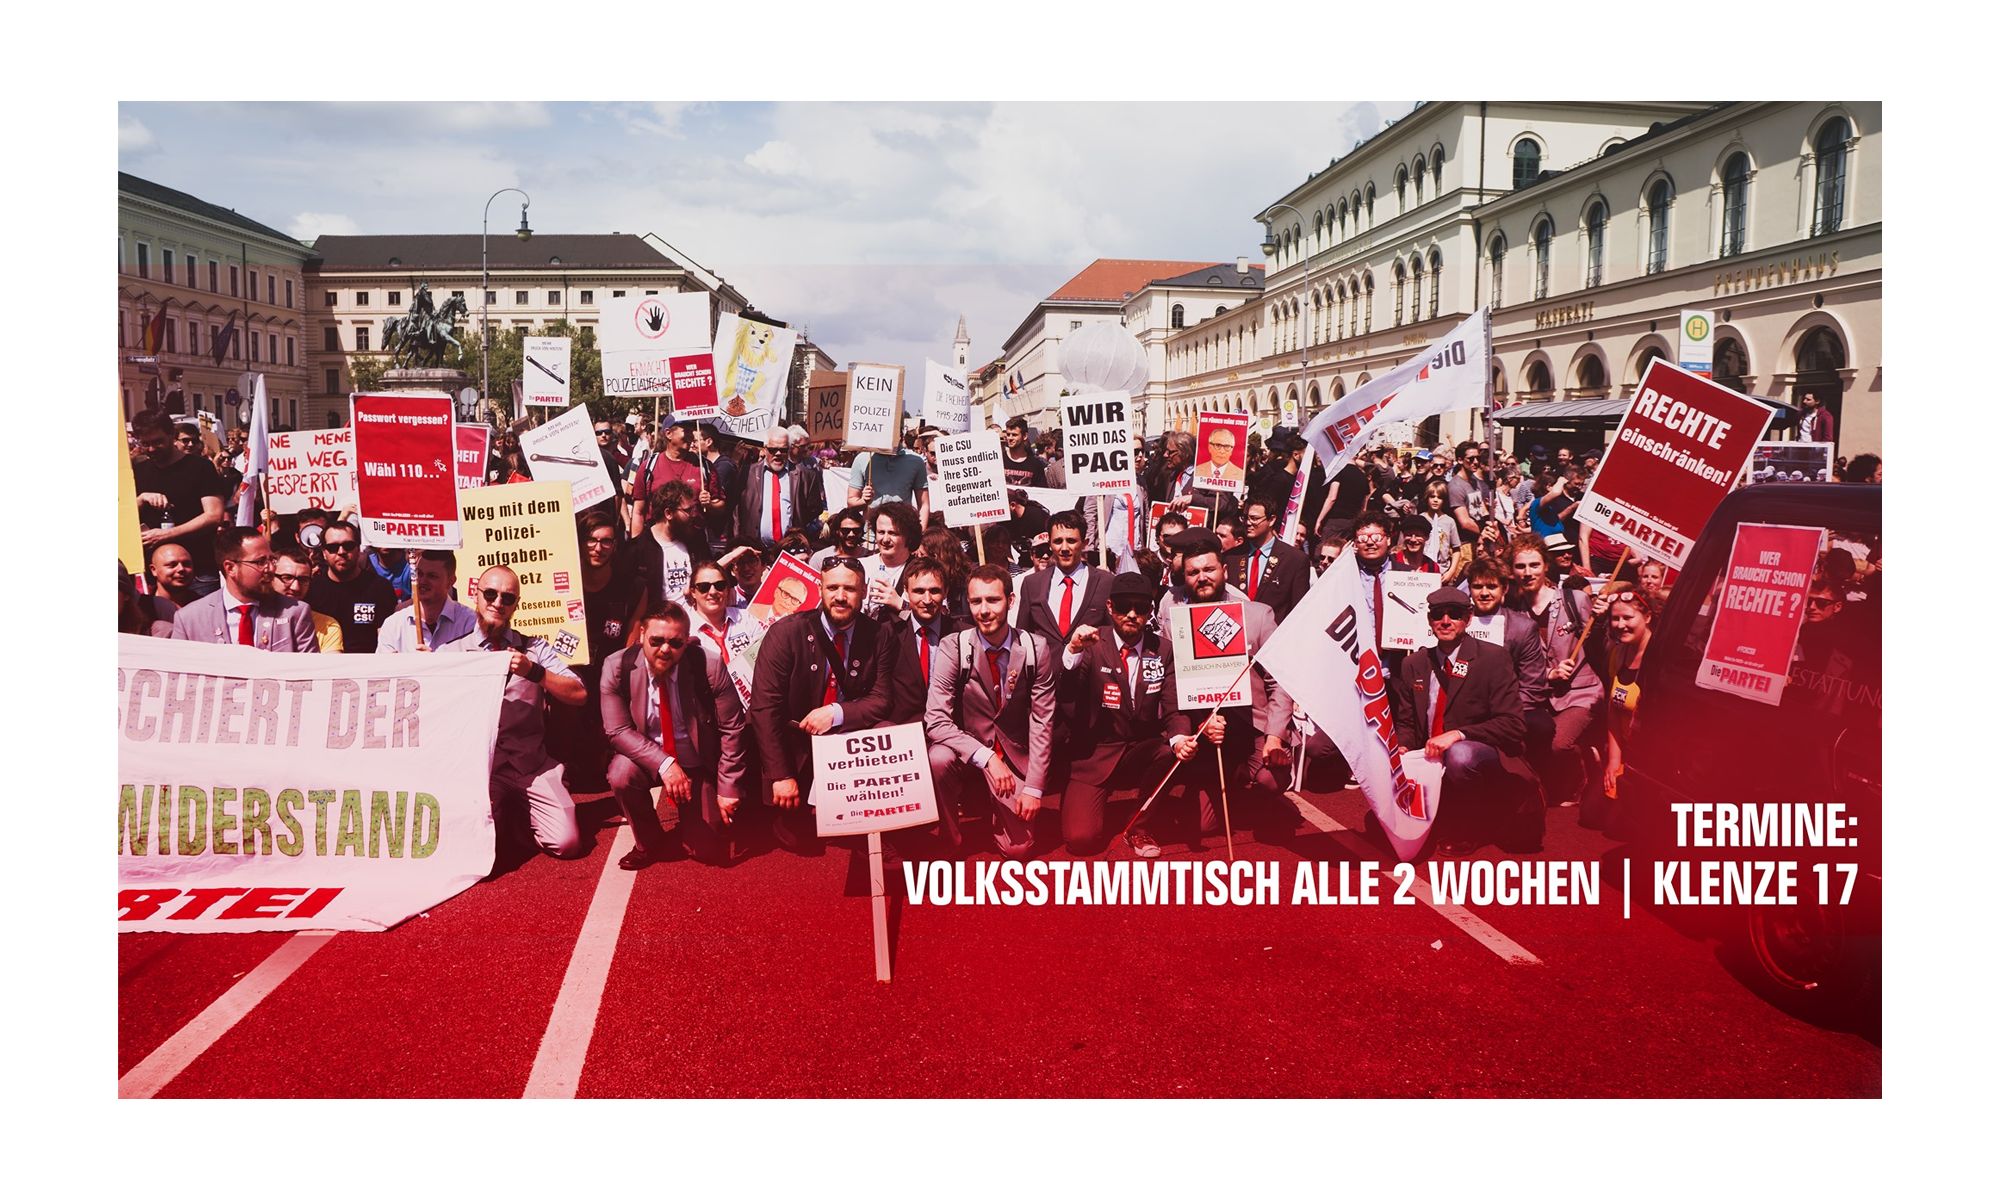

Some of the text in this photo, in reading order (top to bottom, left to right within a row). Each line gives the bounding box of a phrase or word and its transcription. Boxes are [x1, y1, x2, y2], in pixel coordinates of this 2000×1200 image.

[1714, 250, 1838, 293] FREUDENHAUS
[1535, 301, 1595, 326] MASERATI
[675, 377, 706, 390] RECHTE
[856, 376, 893, 392] KEIN
[820, 391, 839, 409] NO
[358, 411, 448, 426] Passwort vergessen?
[687, 408, 714, 417] PARTEI
[853, 405, 890, 417] POLIZEI
[1066, 402, 1124, 427] WIR
[1634, 387, 1732, 450] RECHTE
[814, 409, 843, 434] PAG
[852, 422, 884, 433] STAAT
[314, 431, 351, 446] MENE
[940, 440, 972, 453] Die CSU
[1069, 429, 1126, 448] SIND DAS
[306, 450, 348, 468] WEG
[942, 450, 998, 467] muss endlich
[1071, 450, 1128, 474] PAG
[1620, 427, 1732, 488] einschränken!
[364, 462, 396, 478] Wähl
[944, 466, 982, 480] ihre SED-
[458, 476, 484, 489] TAAT
[946, 478, 992, 494] Gegenwart
[1100, 480, 1130, 488] PARTEI
[1206, 478, 1236, 488] PARTEI
[308, 496, 335, 510] DU
[572, 485, 606, 508] ARTEI
[948, 490, 1000, 507] aufarbeiten!
[463, 500, 560, 521] Weg mit dem
[976, 509, 1005, 518] PARTEI
[374, 521, 445, 536] Die PARTEI
[486, 524, 541, 543] Polizei-
[1594, 502, 1612, 518] Die
[1609, 510, 1686, 558] PARTEI
[478, 548, 554, 567] aufgaben-
[1759, 550, 1782, 566] WER
[668, 571, 686, 579] FCK
[668, 578, 686, 586] CSU
[1732, 566, 1806, 588] BRAUCHT SCHON
[522, 600, 562, 610] Gesetzen
[1724, 585, 1787, 616] RECHTE
[354, 605, 376, 614] FCK
[354, 614, 375, 622] CSU
[514, 614, 566, 628] Faschismus
[605, 620, 622, 631] FCK
[557, 631, 580, 648] FCK
[603, 628, 620, 637] AFD
[553, 640, 576, 656] CSU
[1142, 660, 1164, 669] FCK
[1143, 667, 1164, 679] CSU
[1710, 664, 1772, 693] Die PARTEI
[1188, 694, 1198, 702] Die
[118, 668, 421, 749] CHIERT DER
[846, 734, 892, 754] CSU
[828, 750, 914, 770] verbieten!
[827, 772, 920, 791] Die PARTEI
[846, 786, 904, 802] wählen!
[863, 803, 921, 818] PARTEI
[118, 784, 440, 859] WIDERSTAND
